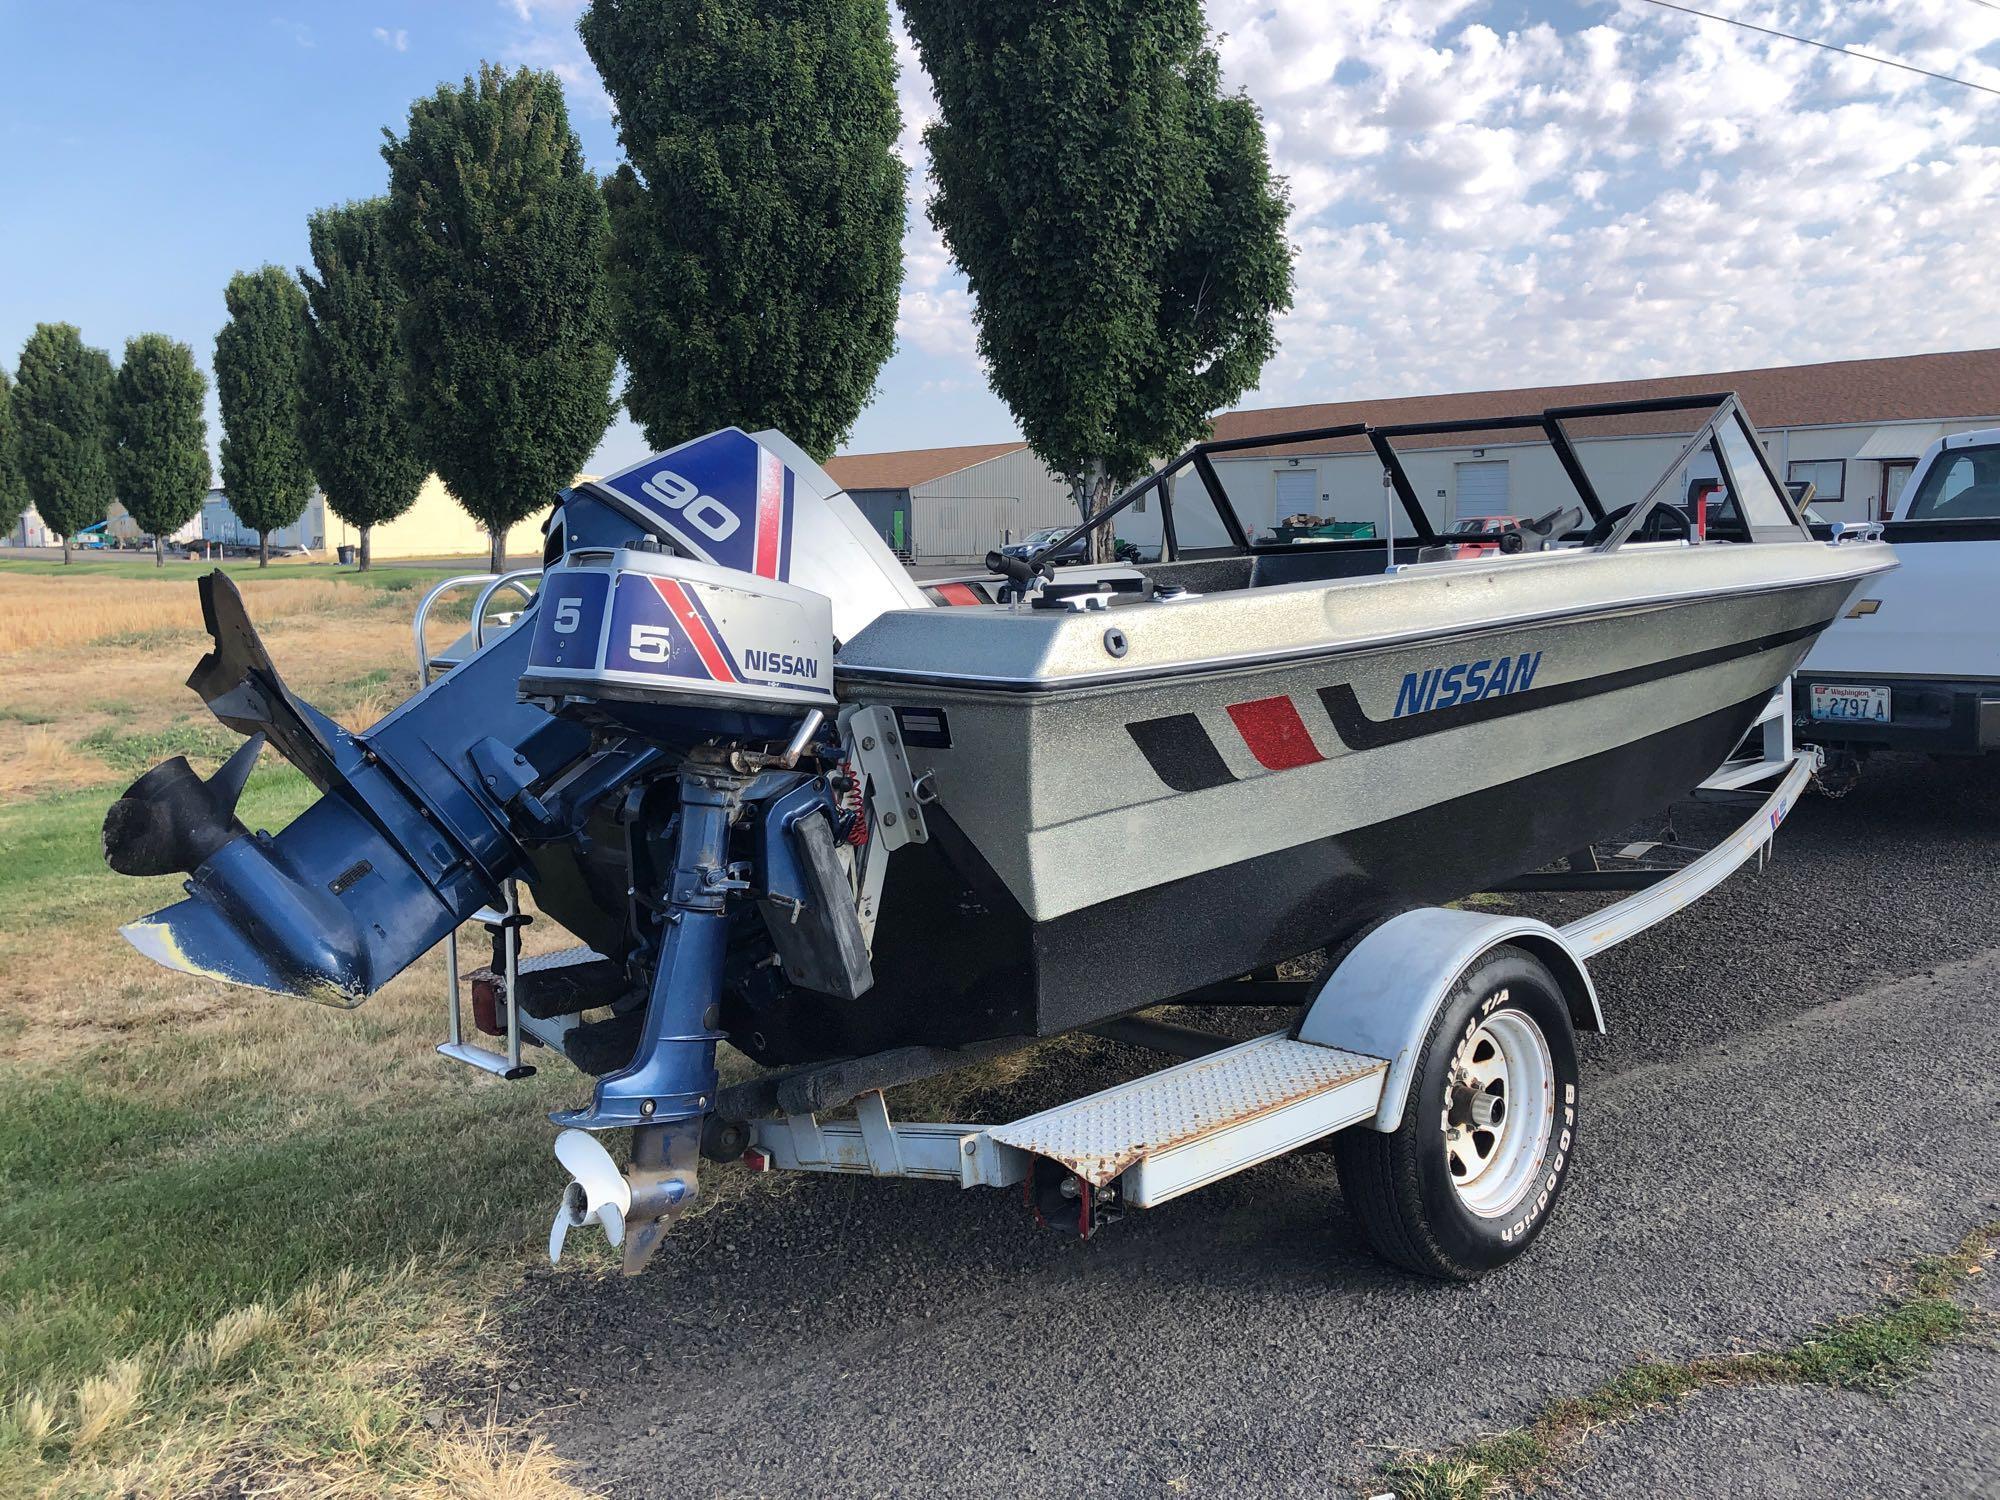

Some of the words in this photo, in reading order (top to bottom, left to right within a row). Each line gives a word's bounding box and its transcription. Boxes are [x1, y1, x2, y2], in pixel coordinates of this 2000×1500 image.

[641, 470, 741, 542] 90
[553, 597, 583, 634] 5
[629, 623, 670, 663] 5
[744, 648, 818, 679] NISSAN
[1392, 650, 1544, 718] NISSAN
[1830, 688, 1871, 698] Washington
